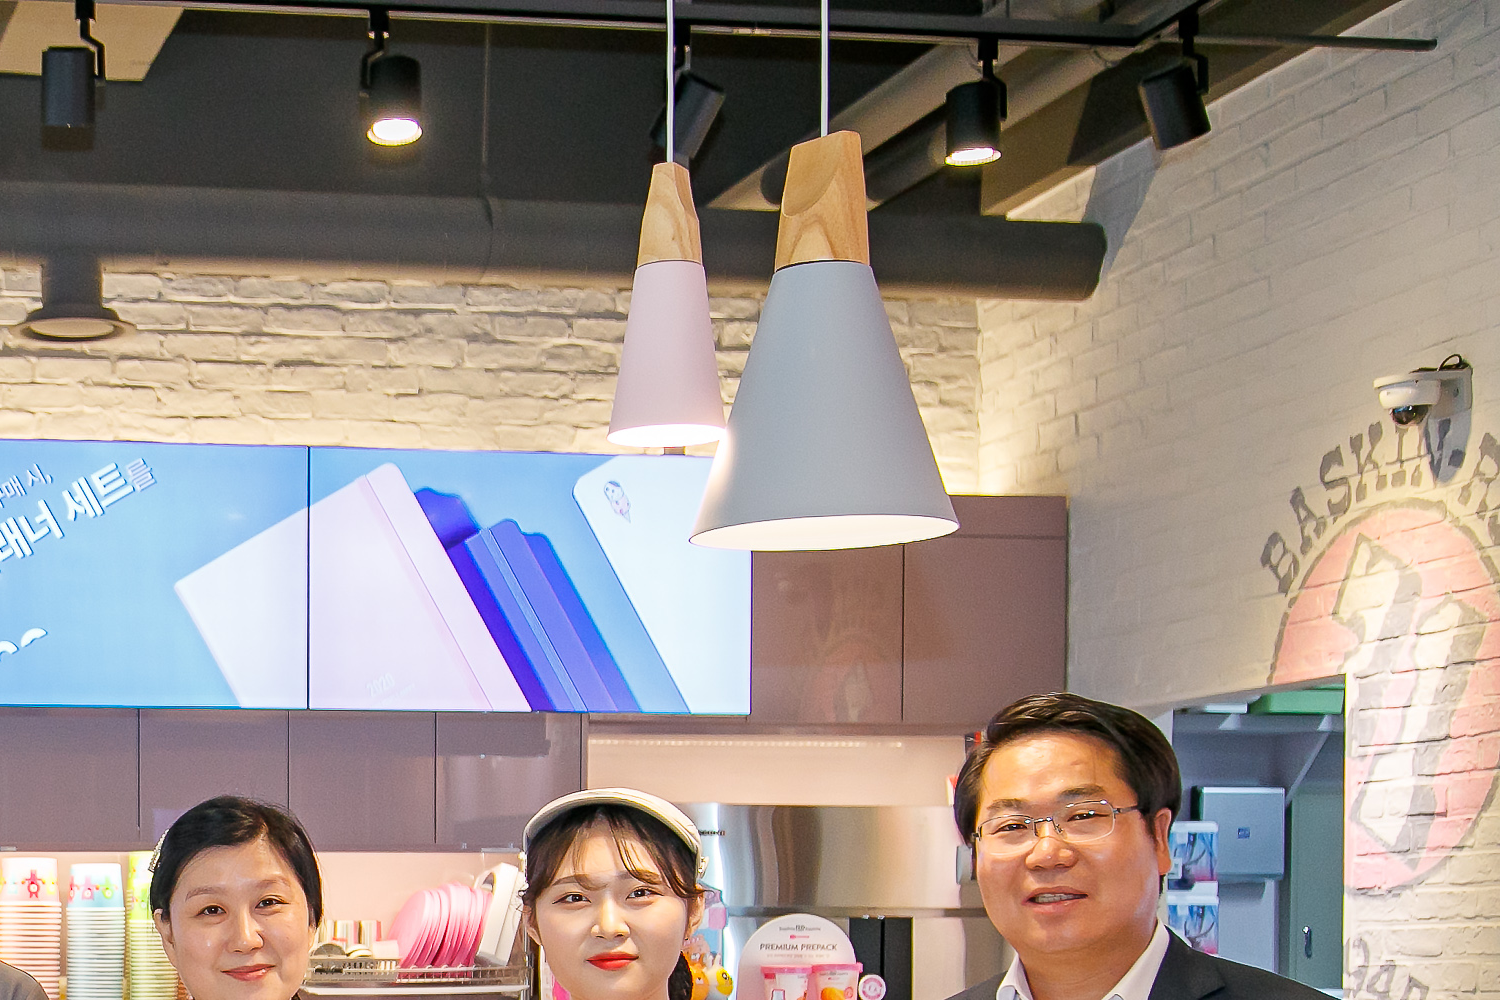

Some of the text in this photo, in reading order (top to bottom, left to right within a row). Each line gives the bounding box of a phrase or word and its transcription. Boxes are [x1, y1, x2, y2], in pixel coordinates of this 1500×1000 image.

[62, 457, 157, 522] 세트를
[760, 943, 838, 951] PREMIUM PREPACK
